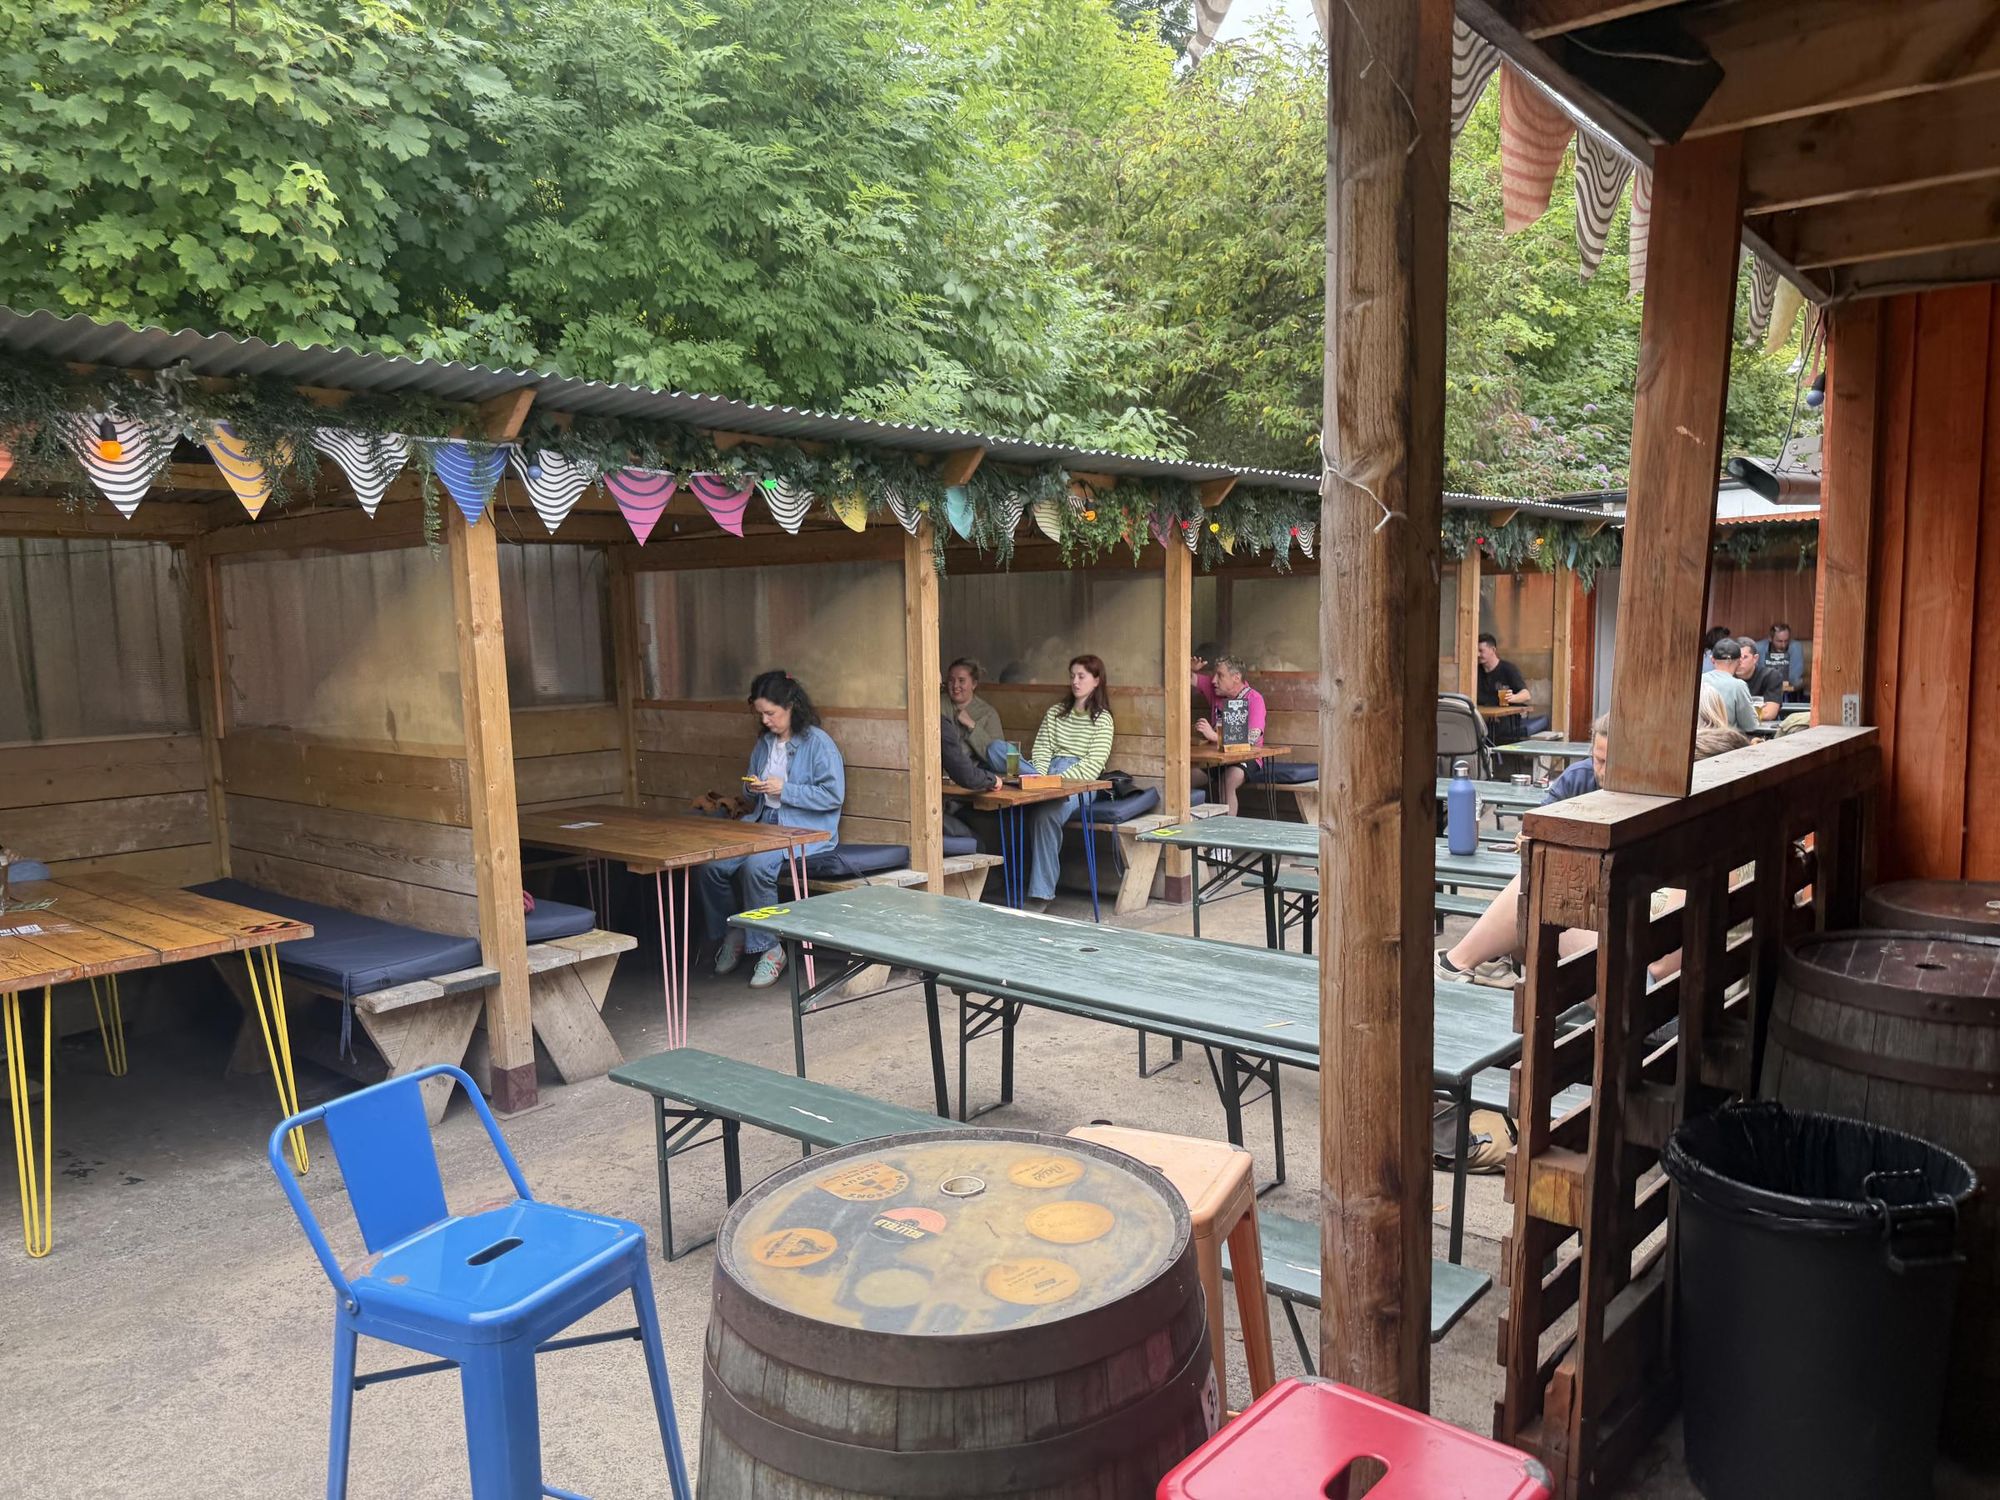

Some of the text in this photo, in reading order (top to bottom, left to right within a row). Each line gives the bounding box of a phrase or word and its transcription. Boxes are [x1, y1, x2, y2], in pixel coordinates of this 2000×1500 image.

[1568, 864, 1585, 911] GLASS
[738, 906, 791, 920] 38
[240, 921, 302, 934] 22
[841, 1172, 879, 1187] STOUT
[874, 1219, 925, 1239] BELLFIELD
